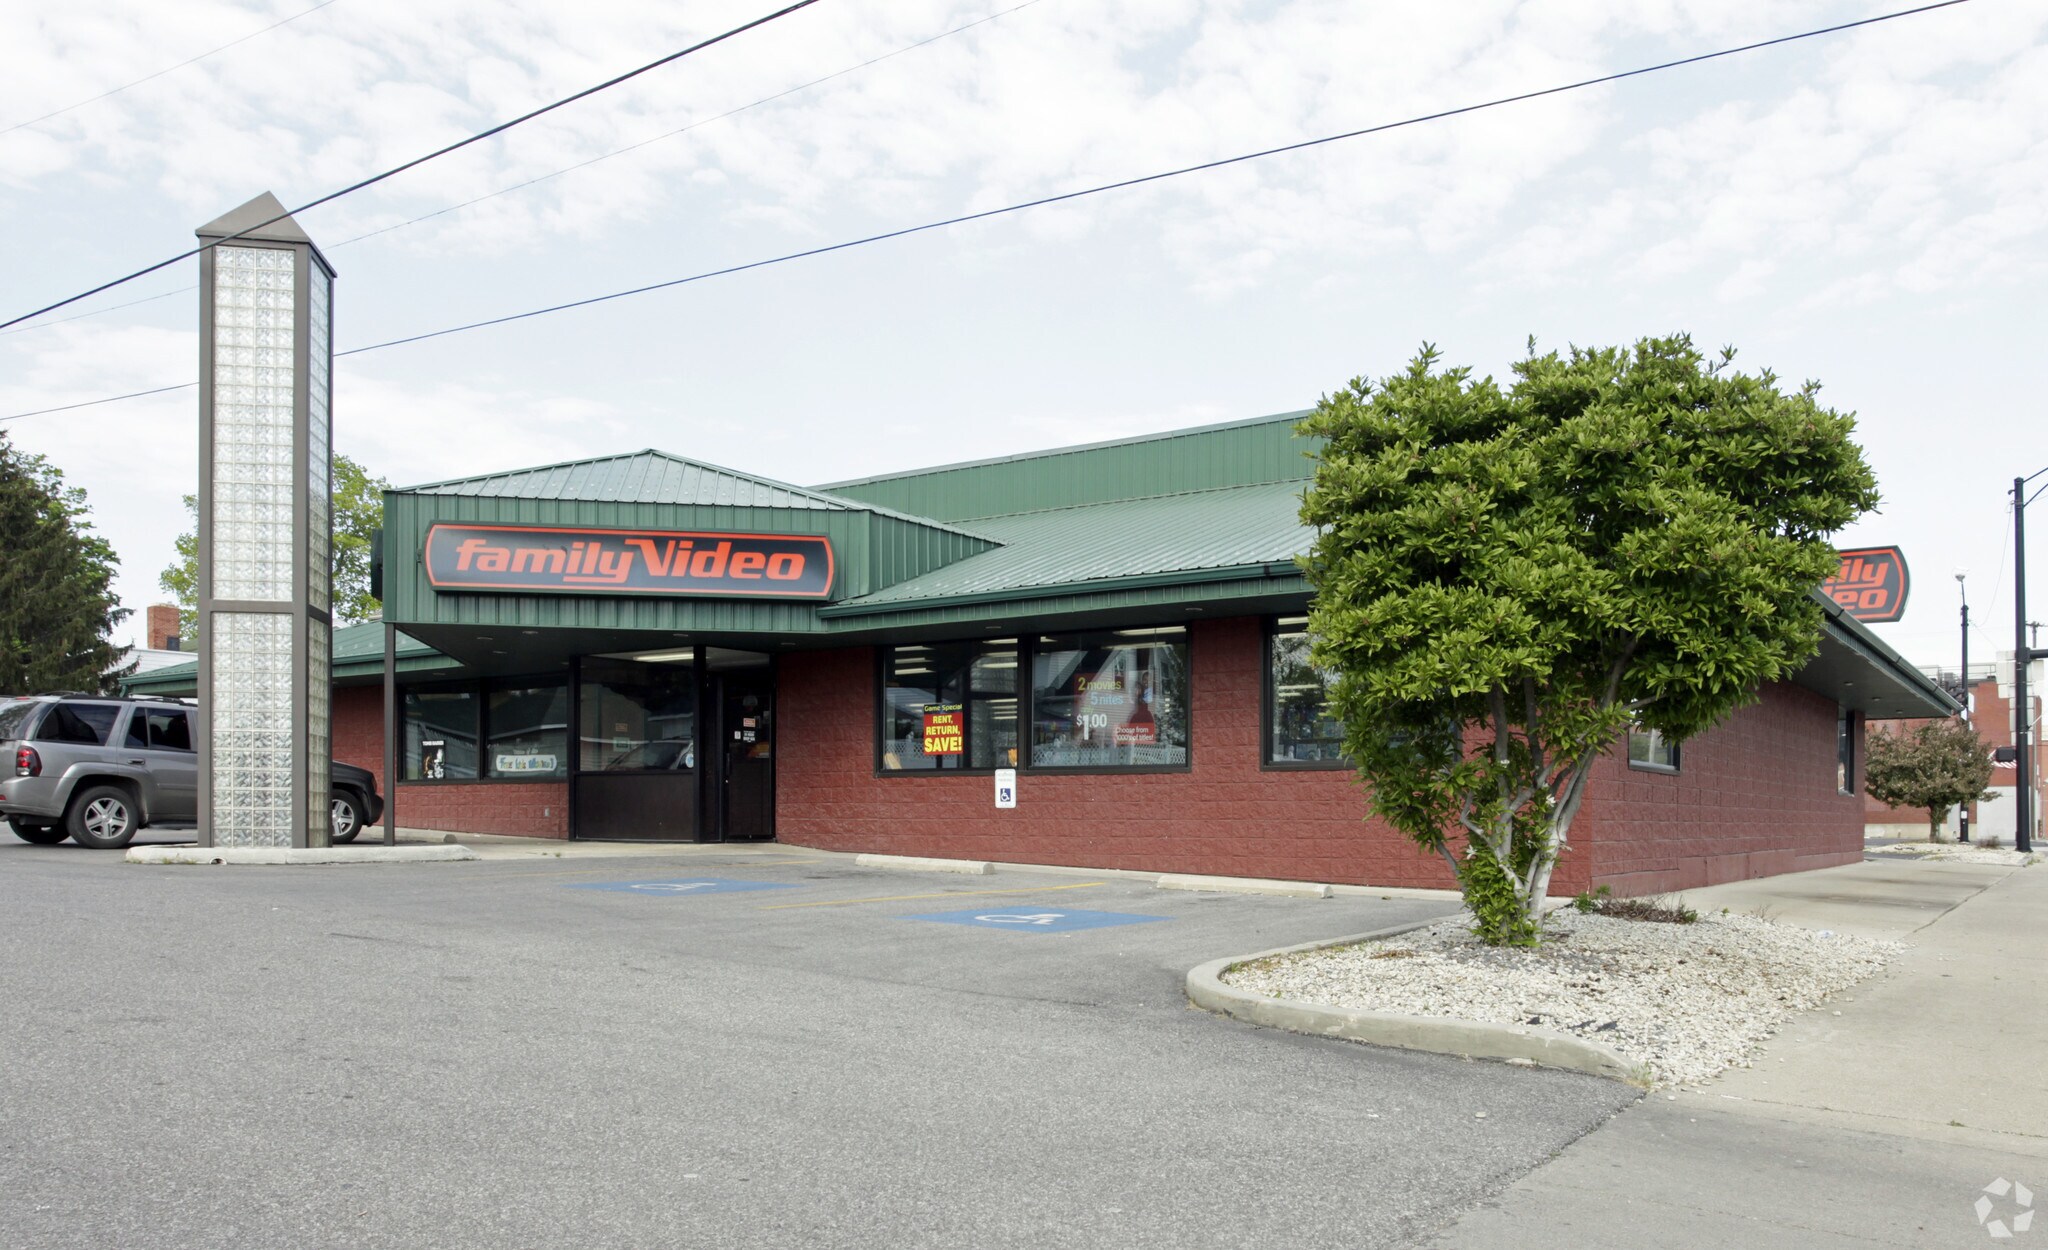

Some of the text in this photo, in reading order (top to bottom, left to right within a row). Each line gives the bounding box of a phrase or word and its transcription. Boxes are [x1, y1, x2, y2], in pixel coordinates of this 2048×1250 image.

[455, 538, 806, 584] family Video
[1825, 558, 1889, 590] ily
[1078, 677, 1122, 690] 2 movies
[1091, 692, 1124, 705] 5 nites
[941, 703, 962, 711] Special
[932, 715, 953, 724] RENT,
[926, 725, 960, 736] RETURN,
[1076, 713, 1107, 741] $1.00
[1136, 725, 1149, 733] from
[924, 737, 962, 753] SAVE!
